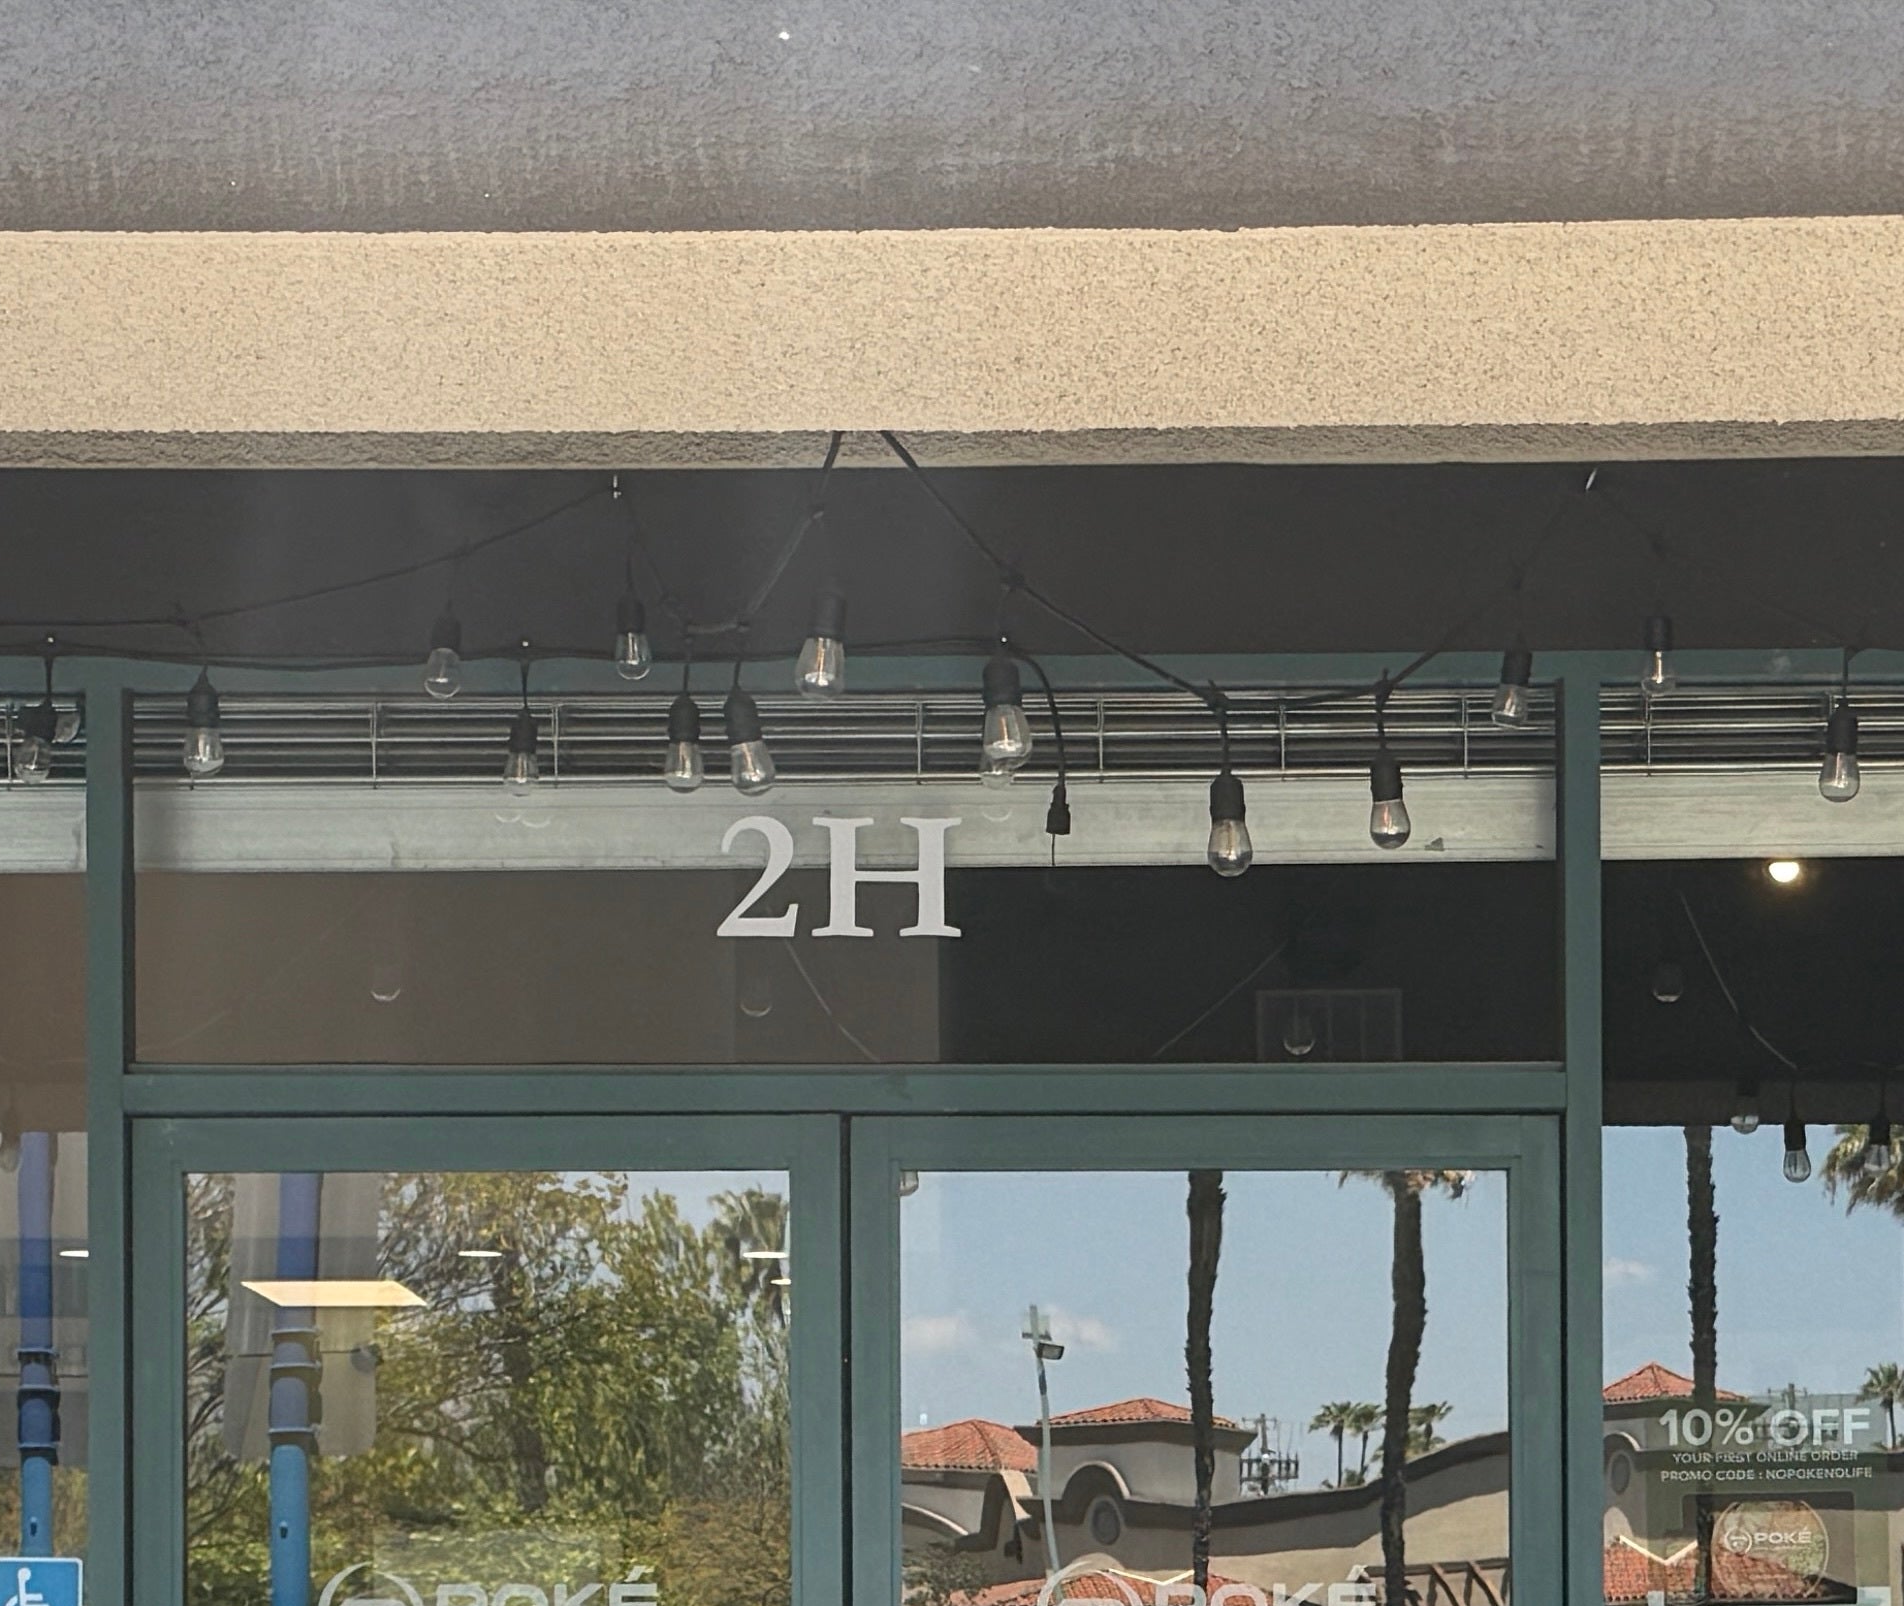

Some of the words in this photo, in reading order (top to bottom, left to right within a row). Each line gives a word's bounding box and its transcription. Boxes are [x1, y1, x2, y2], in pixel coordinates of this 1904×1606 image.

[717, 816, 962, 937] 2H
[1659, 1408, 1754, 1446] 10%
[1770, 1408, 1870, 1447] OFF
[1673, 1453, 1712, 1464] YOUR
[1715, 1453, 1751, 1463] FIRST
[1756, 1451, 1807, 1462] ONLINE
[1811, 1451, 1858, 1461] ORDER
[1661, 1470, 1712, 1481] PROMO
[1715, 1469, 1755, 1480] CODE
[1766, 1467, 1872, 1480] NOPOKENOLIFE
